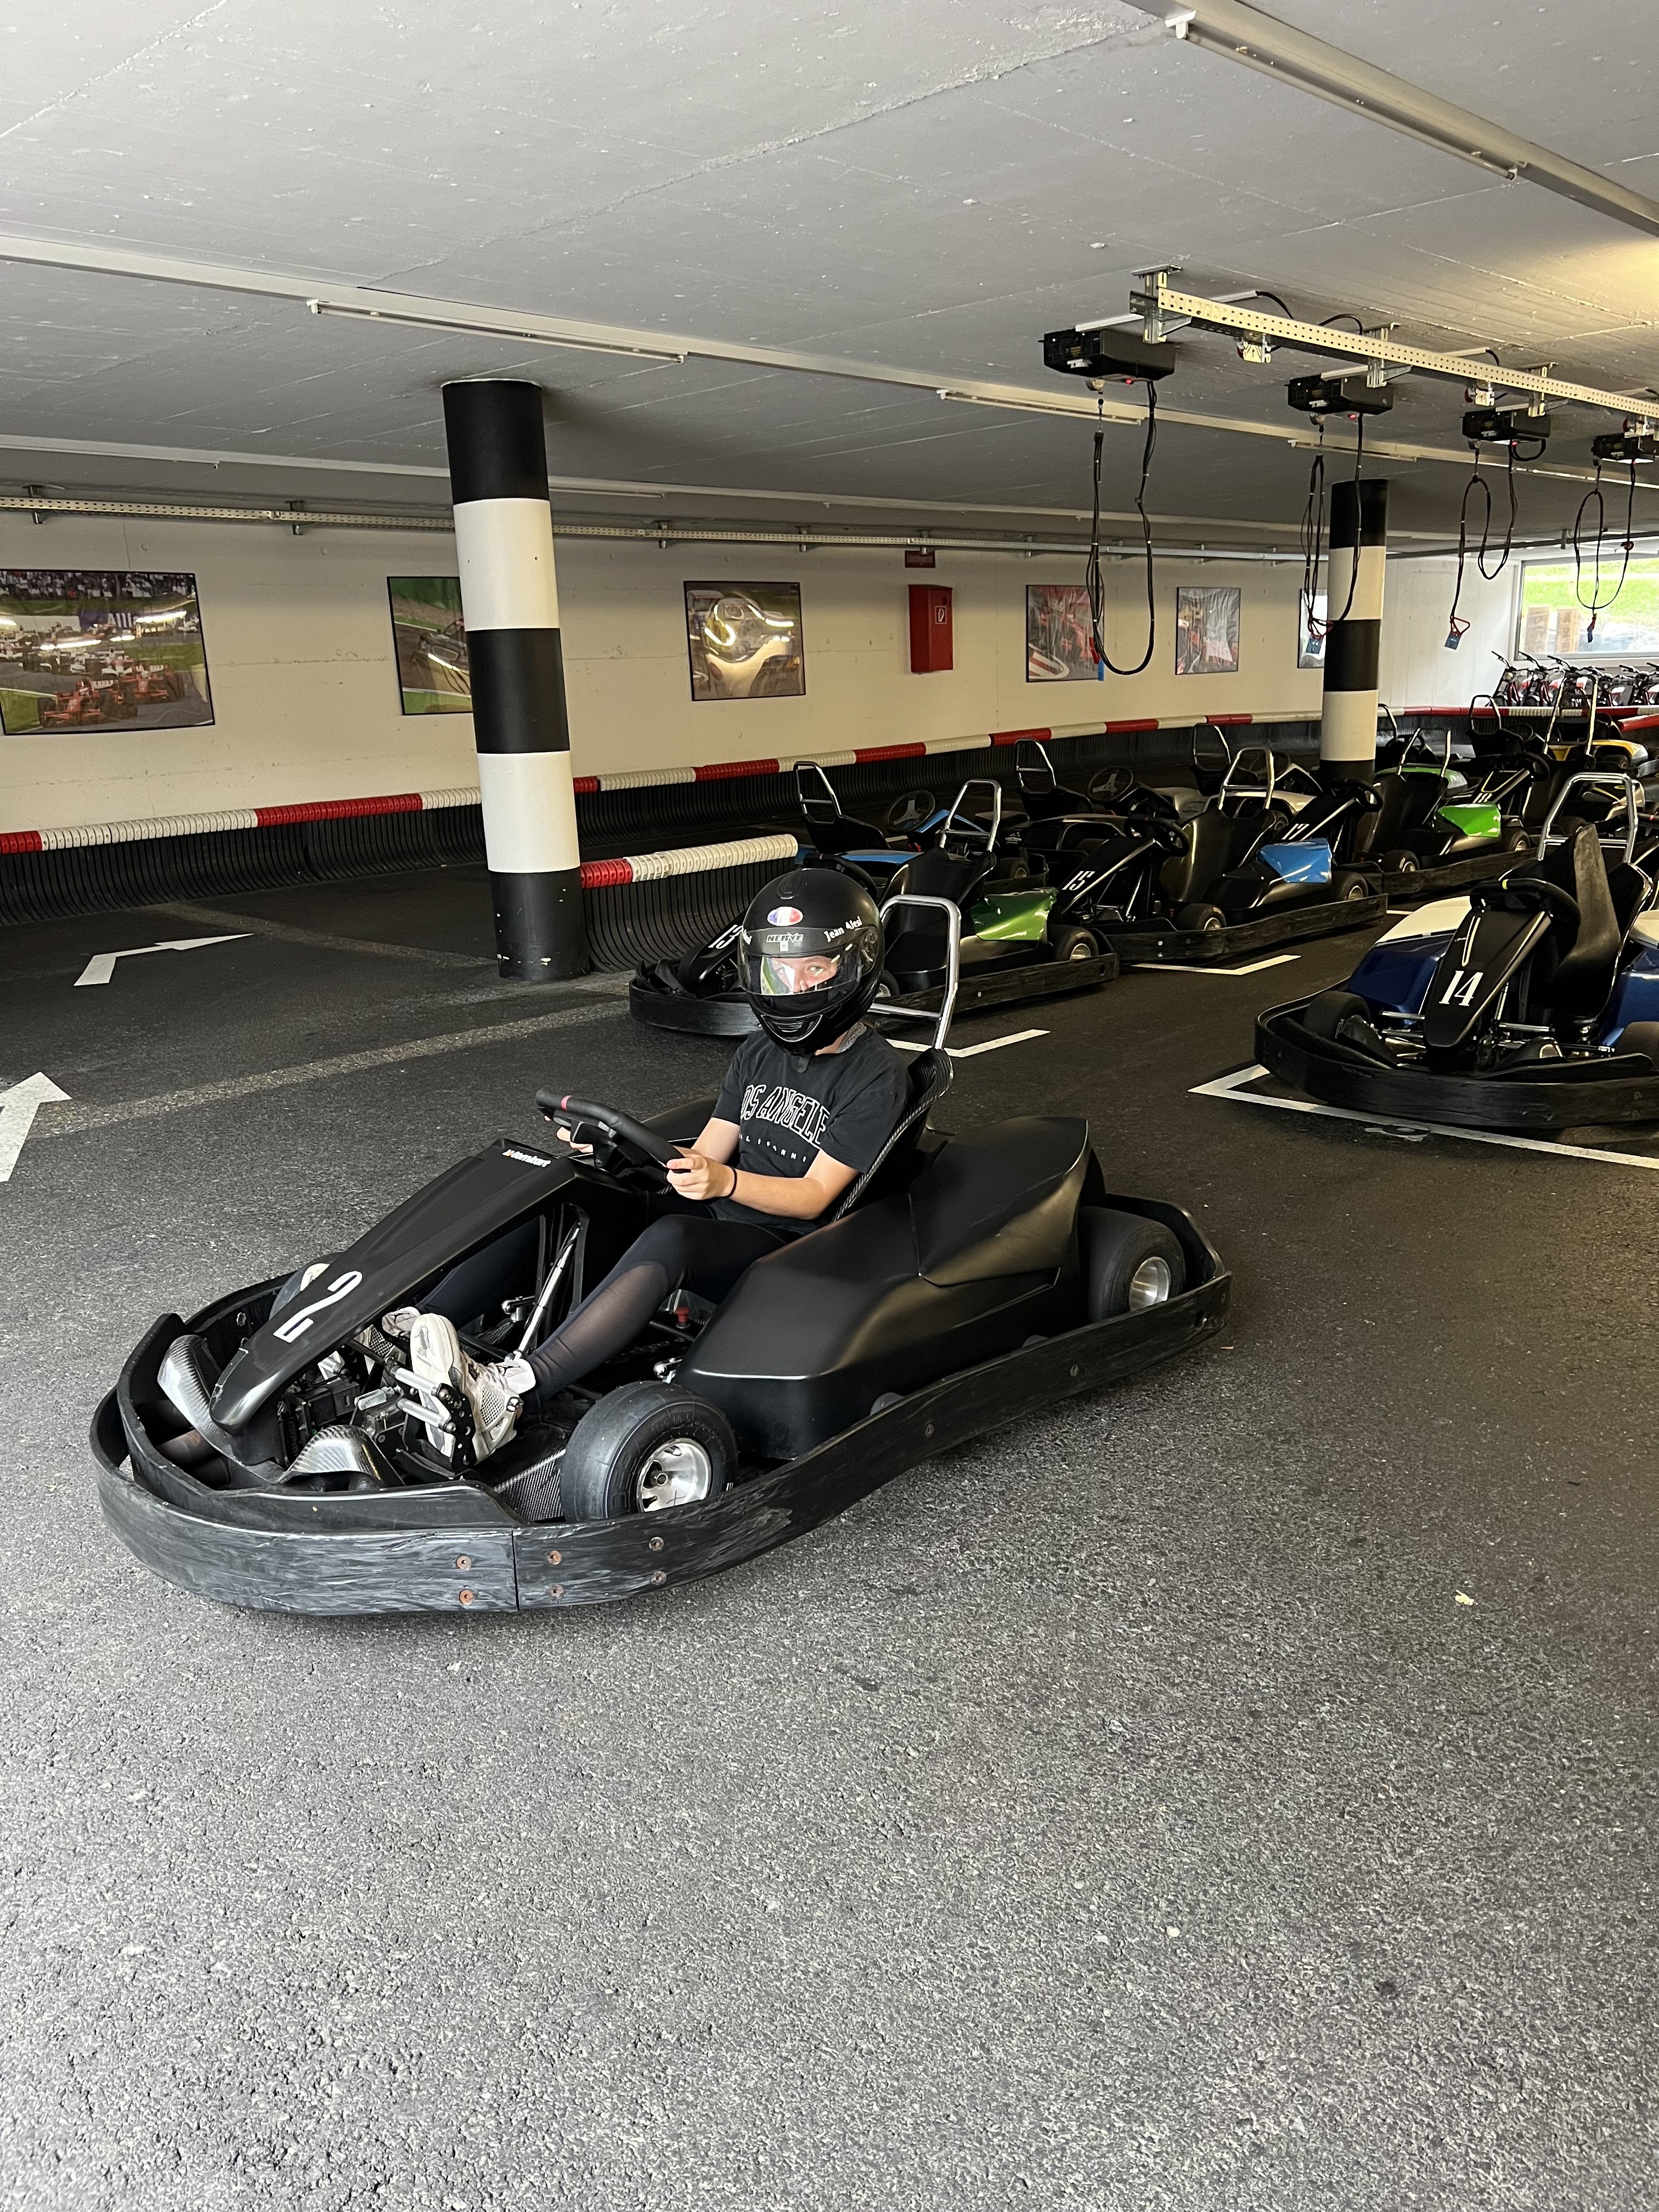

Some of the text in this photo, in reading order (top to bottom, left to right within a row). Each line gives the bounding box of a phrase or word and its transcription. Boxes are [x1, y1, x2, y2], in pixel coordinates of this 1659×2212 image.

[1281, 823, 1310, 840] 17
[1061, 871, 1096, 890] 15
[708, 924, 743, 949] 13
[766, 932, 804, 943] NERVE
[823, 927, 845, 943] Jean
[1438, 970, 1484, 1006] 14
[273, 1271, 363, 1343] 2
